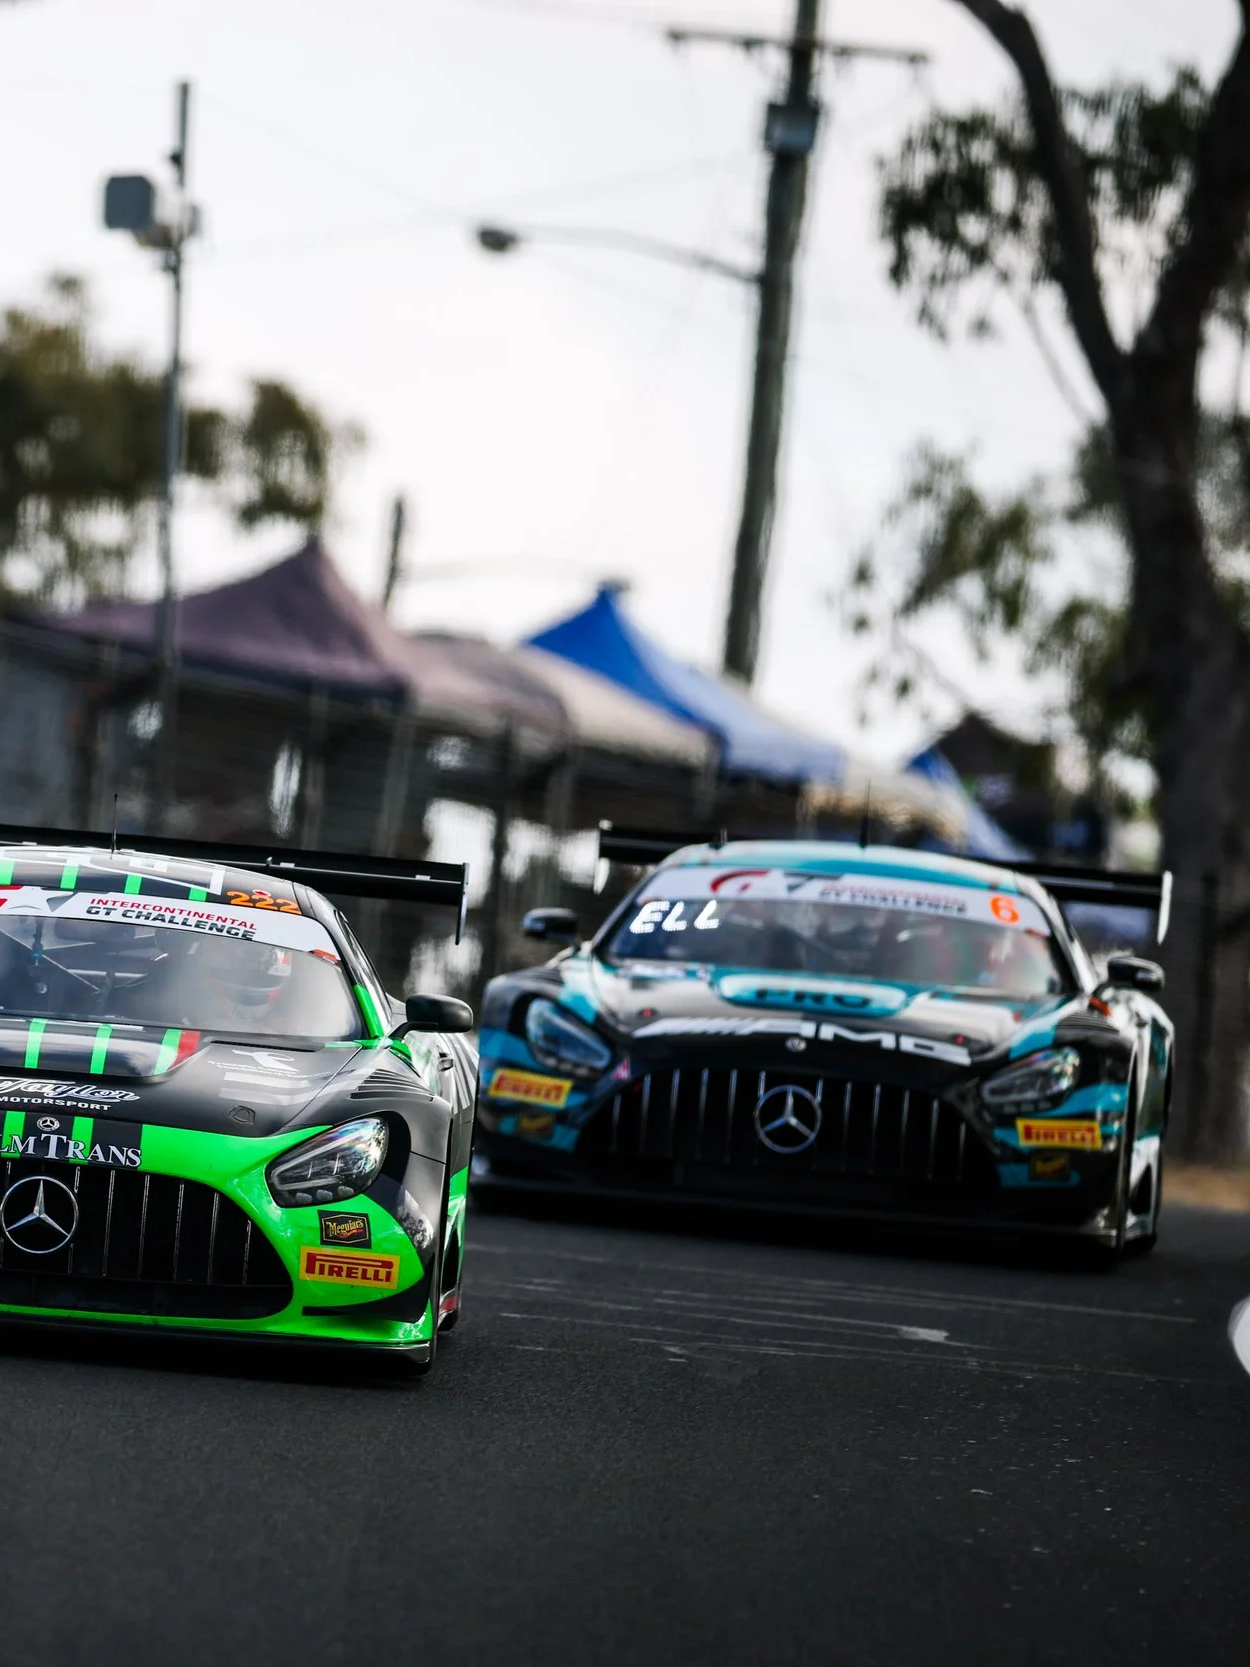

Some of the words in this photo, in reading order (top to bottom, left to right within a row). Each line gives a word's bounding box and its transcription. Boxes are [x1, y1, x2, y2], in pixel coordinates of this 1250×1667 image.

[91, 898, 257, 931] INTERCONTINENTAL
[227, 890, 302, 915] 222
[629, 899, 720, 934] ELL
[990, 896, 1019, 924] 6
[86, 906, 117, 916] GT
[121, 909, 255, 941] CHALLENGE
[756, 986, 871, 1010] PRO
[41, 1133, 142, 1168] TRANS
[305, 1252, 394, 1283] PIRELLI
